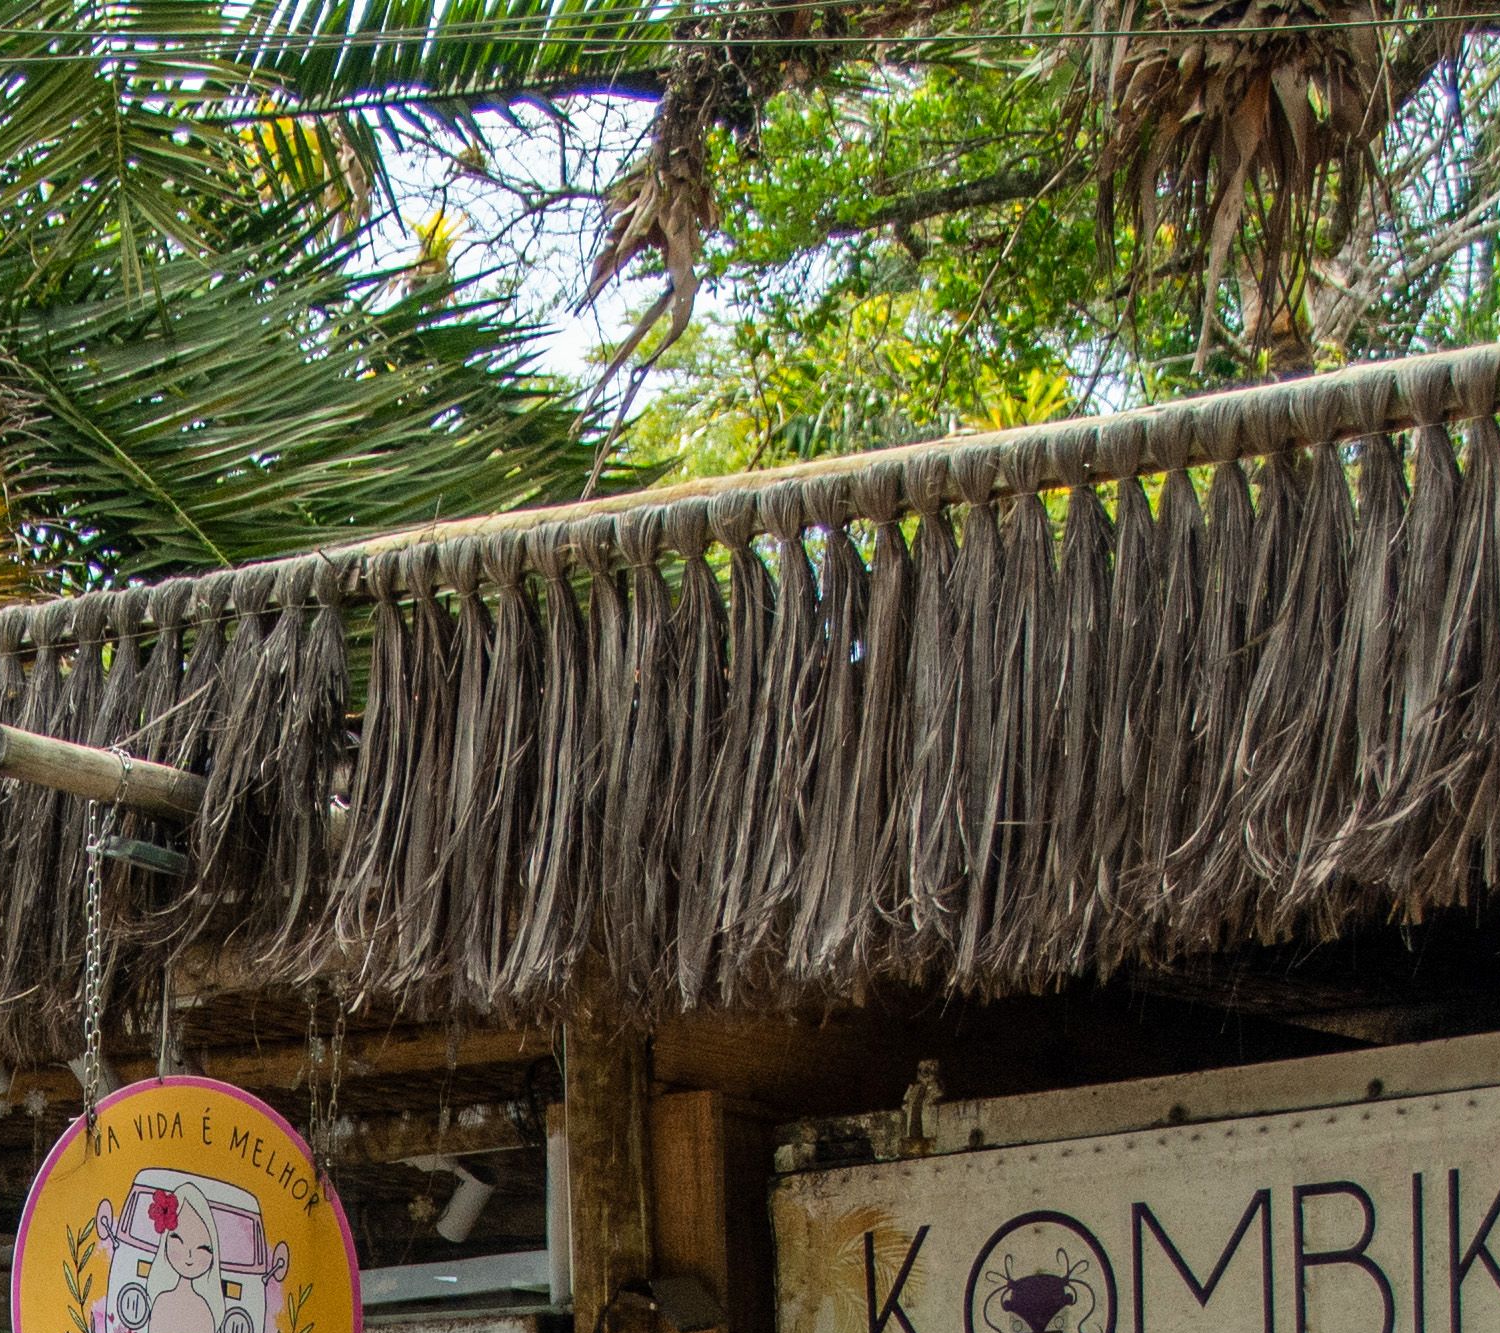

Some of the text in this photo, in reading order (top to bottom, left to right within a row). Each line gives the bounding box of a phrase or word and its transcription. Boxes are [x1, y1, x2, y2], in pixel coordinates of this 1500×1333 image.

[108, 1107, 320, 1217] A VIDA É MELHOR
